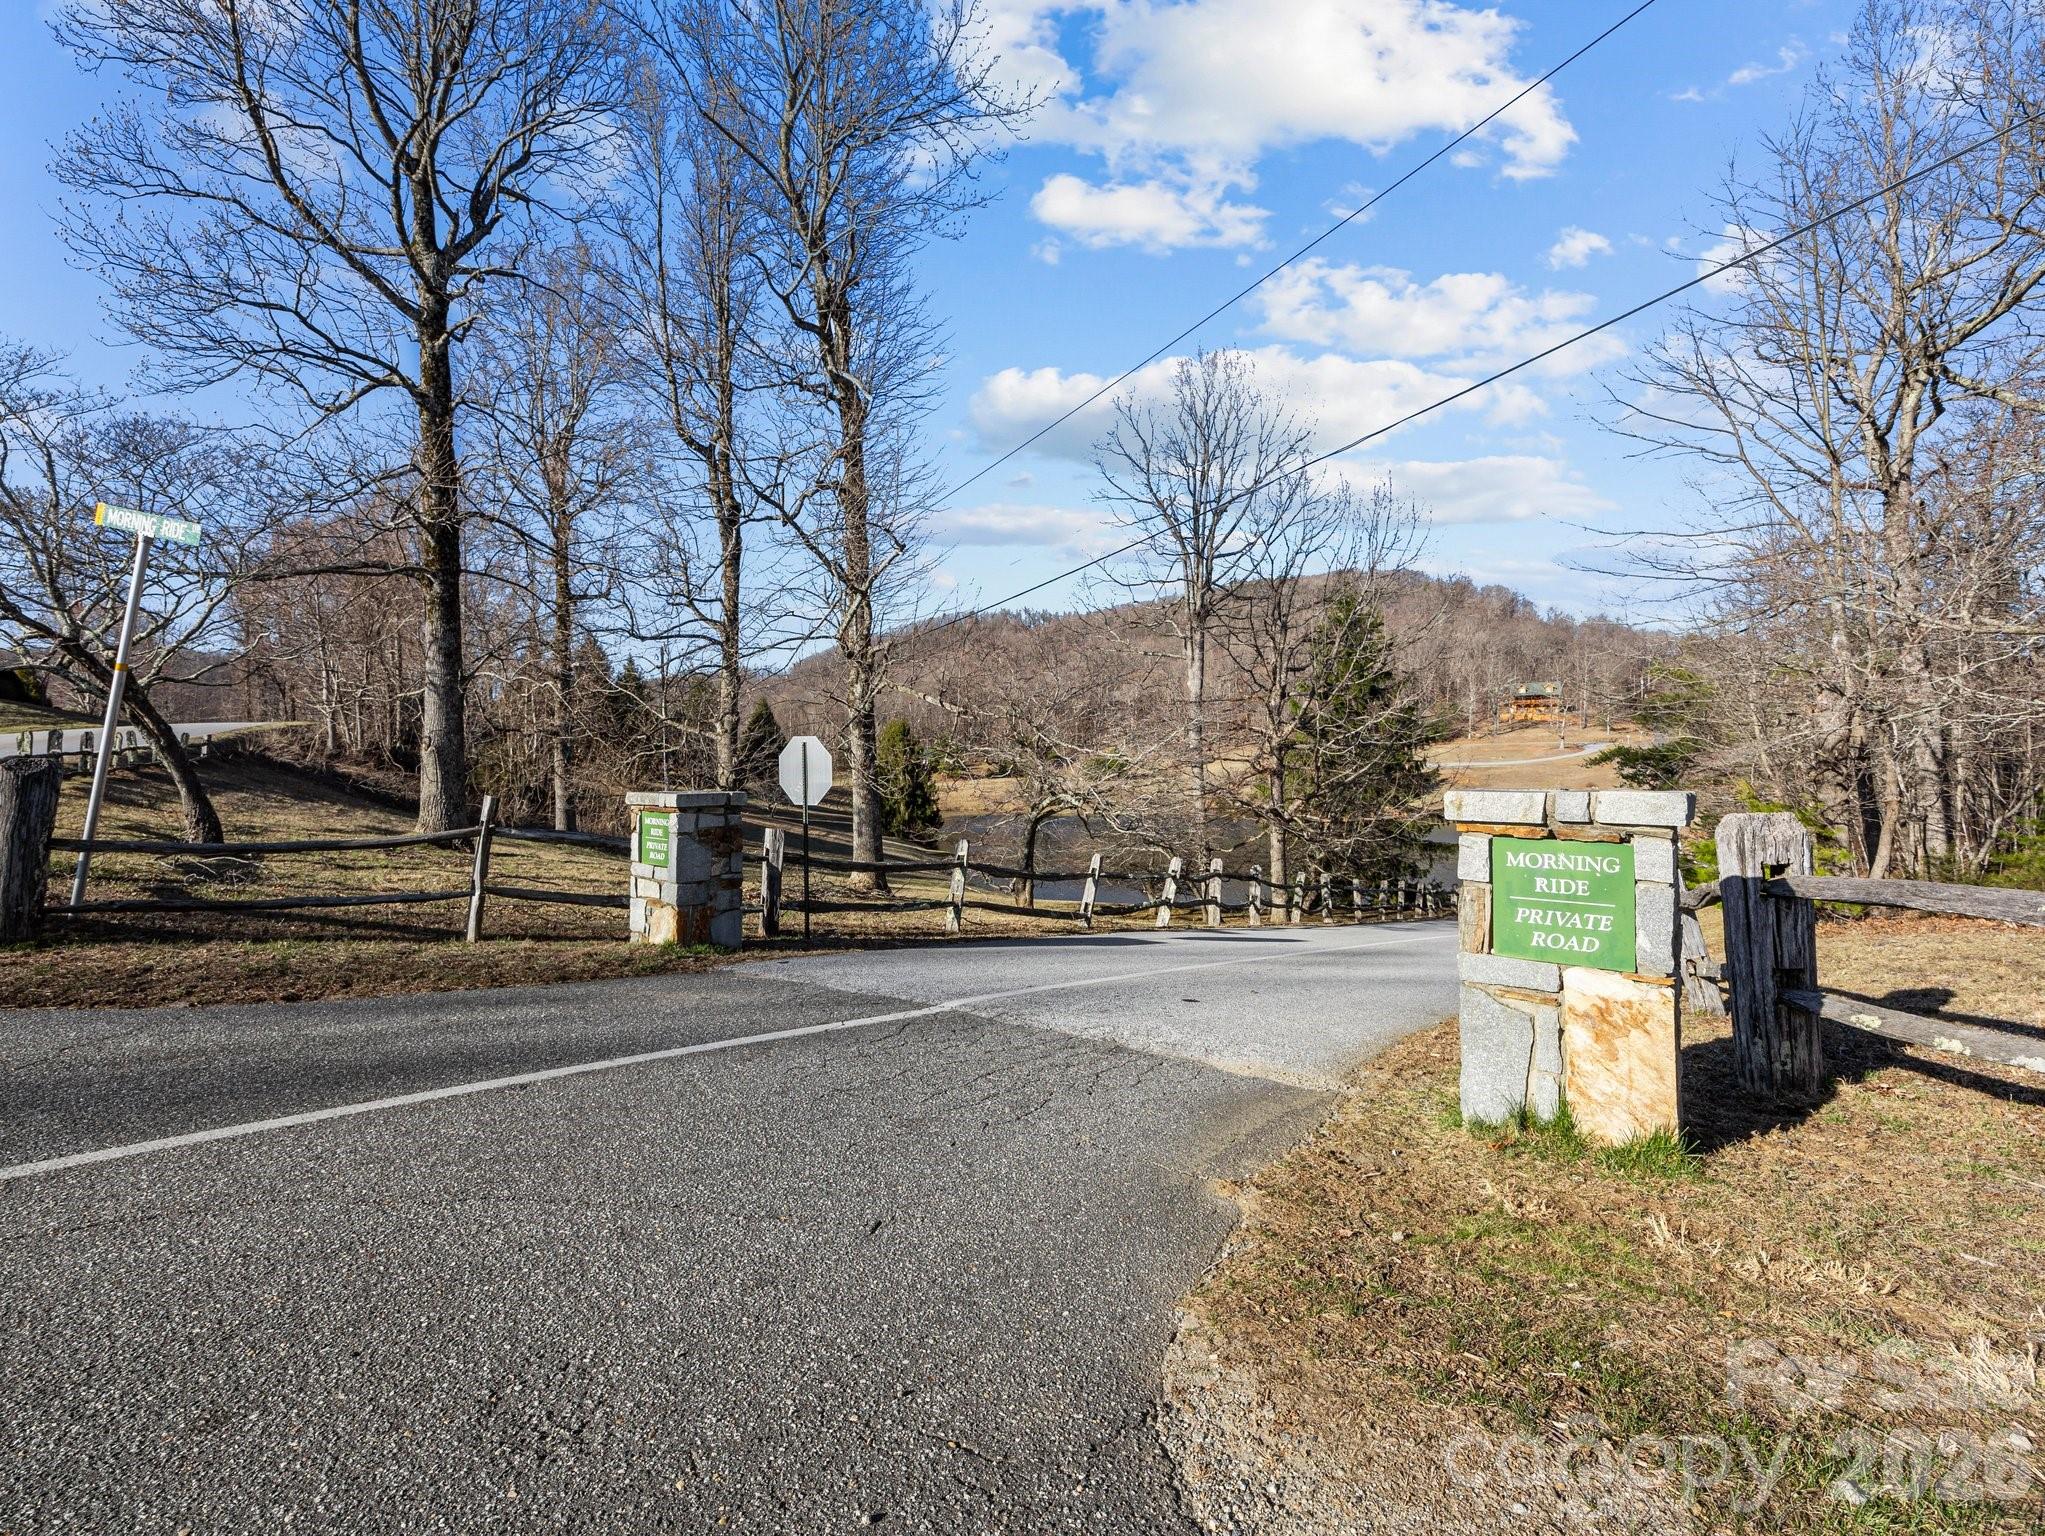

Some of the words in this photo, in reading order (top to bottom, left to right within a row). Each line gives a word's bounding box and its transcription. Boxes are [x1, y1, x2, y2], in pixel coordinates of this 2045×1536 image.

[107, 508, 157, 534] MORNING
[161, 519, 187, 541] RIDE
[644, 816, 669, 827] MORNING
[650, 828, 663, 837] RIDE
[646, 841, 668, 851] PRIVATE
[649, 851, 666, 860] ROAD
[1506, 851, 1621, 875] MORNING
[1534, 877, 1590, 896] RIDE
[1514, 907, 1614, 932] PRIVATE
[1530, 931, 1600, 953] ROAD
